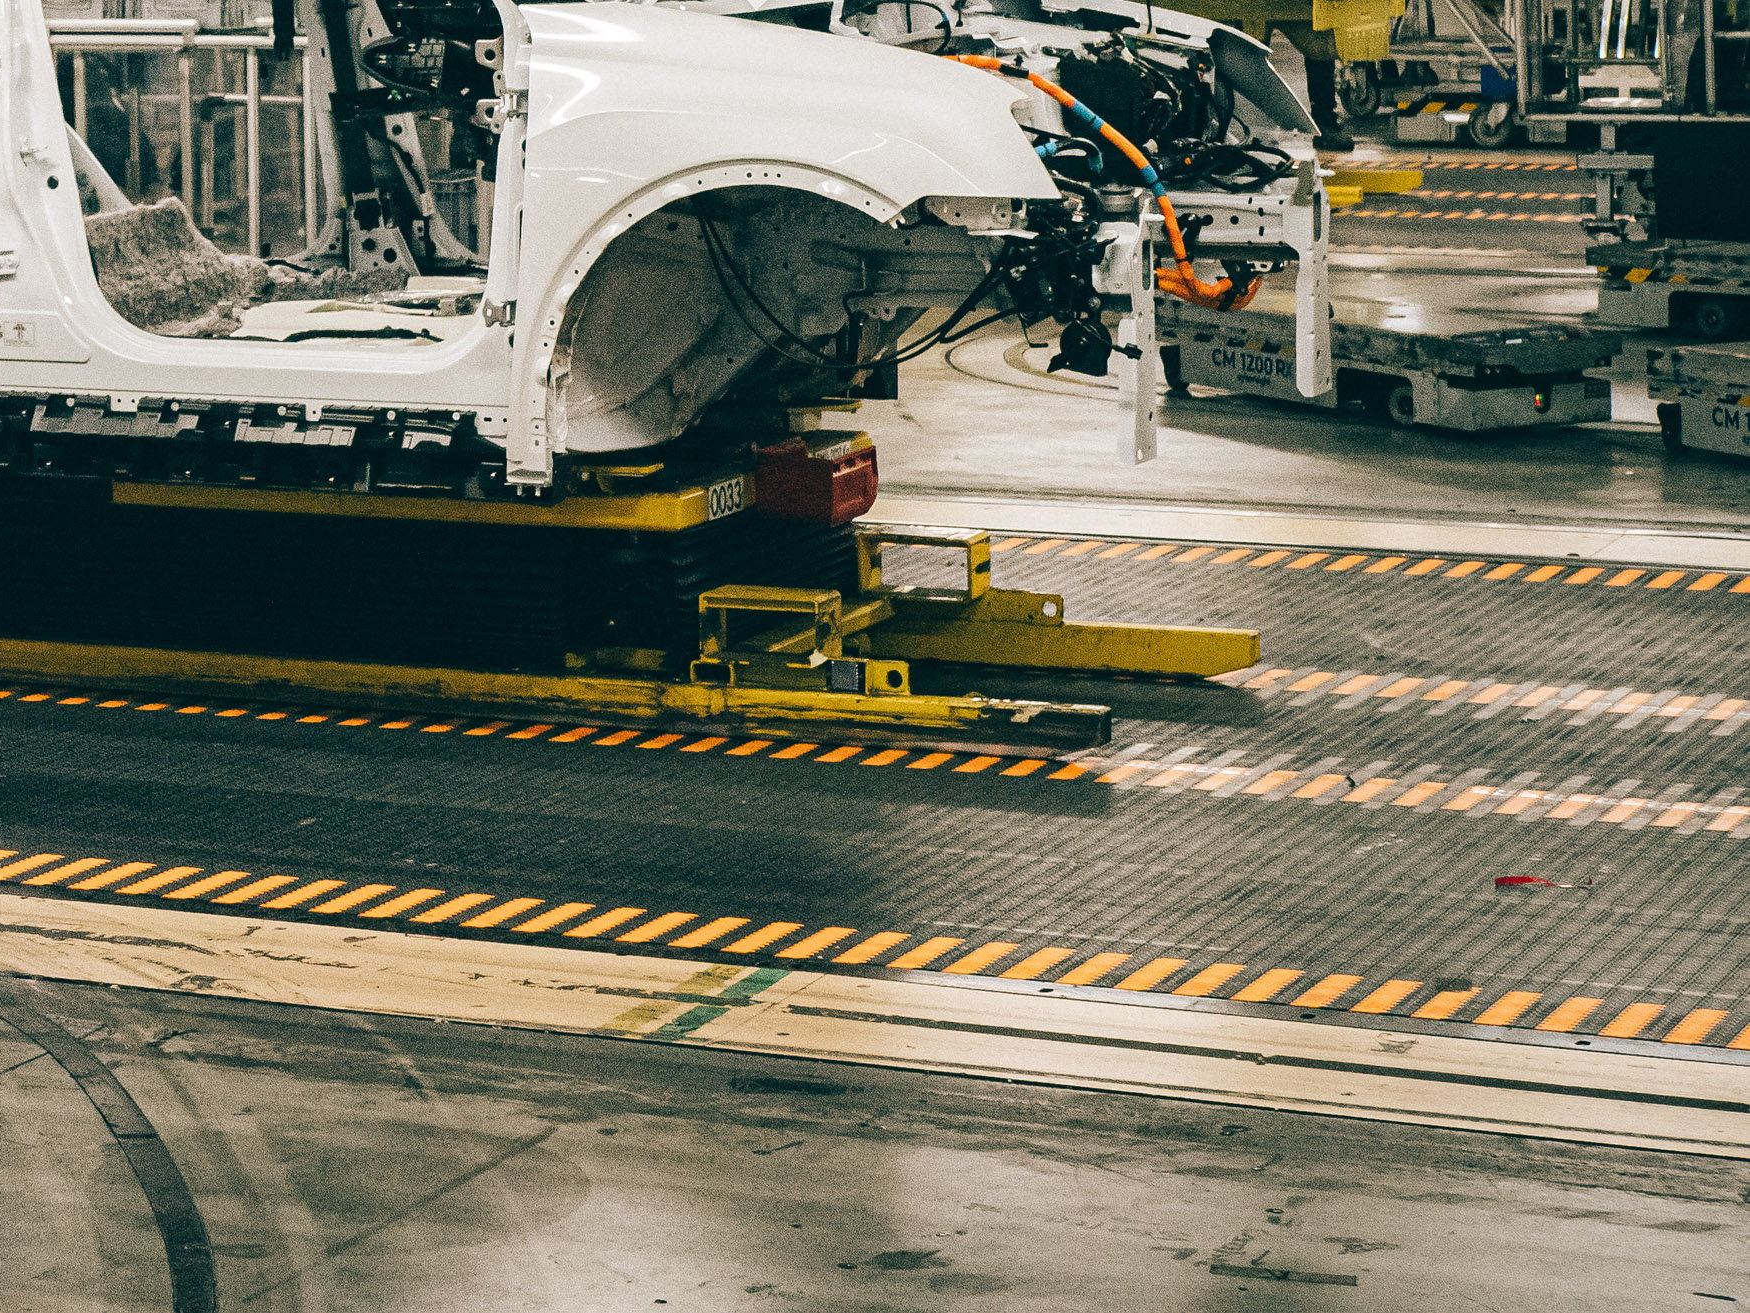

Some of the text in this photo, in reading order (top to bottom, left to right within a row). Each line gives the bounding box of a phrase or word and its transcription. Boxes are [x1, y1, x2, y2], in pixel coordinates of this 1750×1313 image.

[1212, 349, 1235, 368] CM
[1240, 353, 1273, 375] 1200
[1712, 407, 1740, 430] CM
[710, 481, 742, 517] 0033
